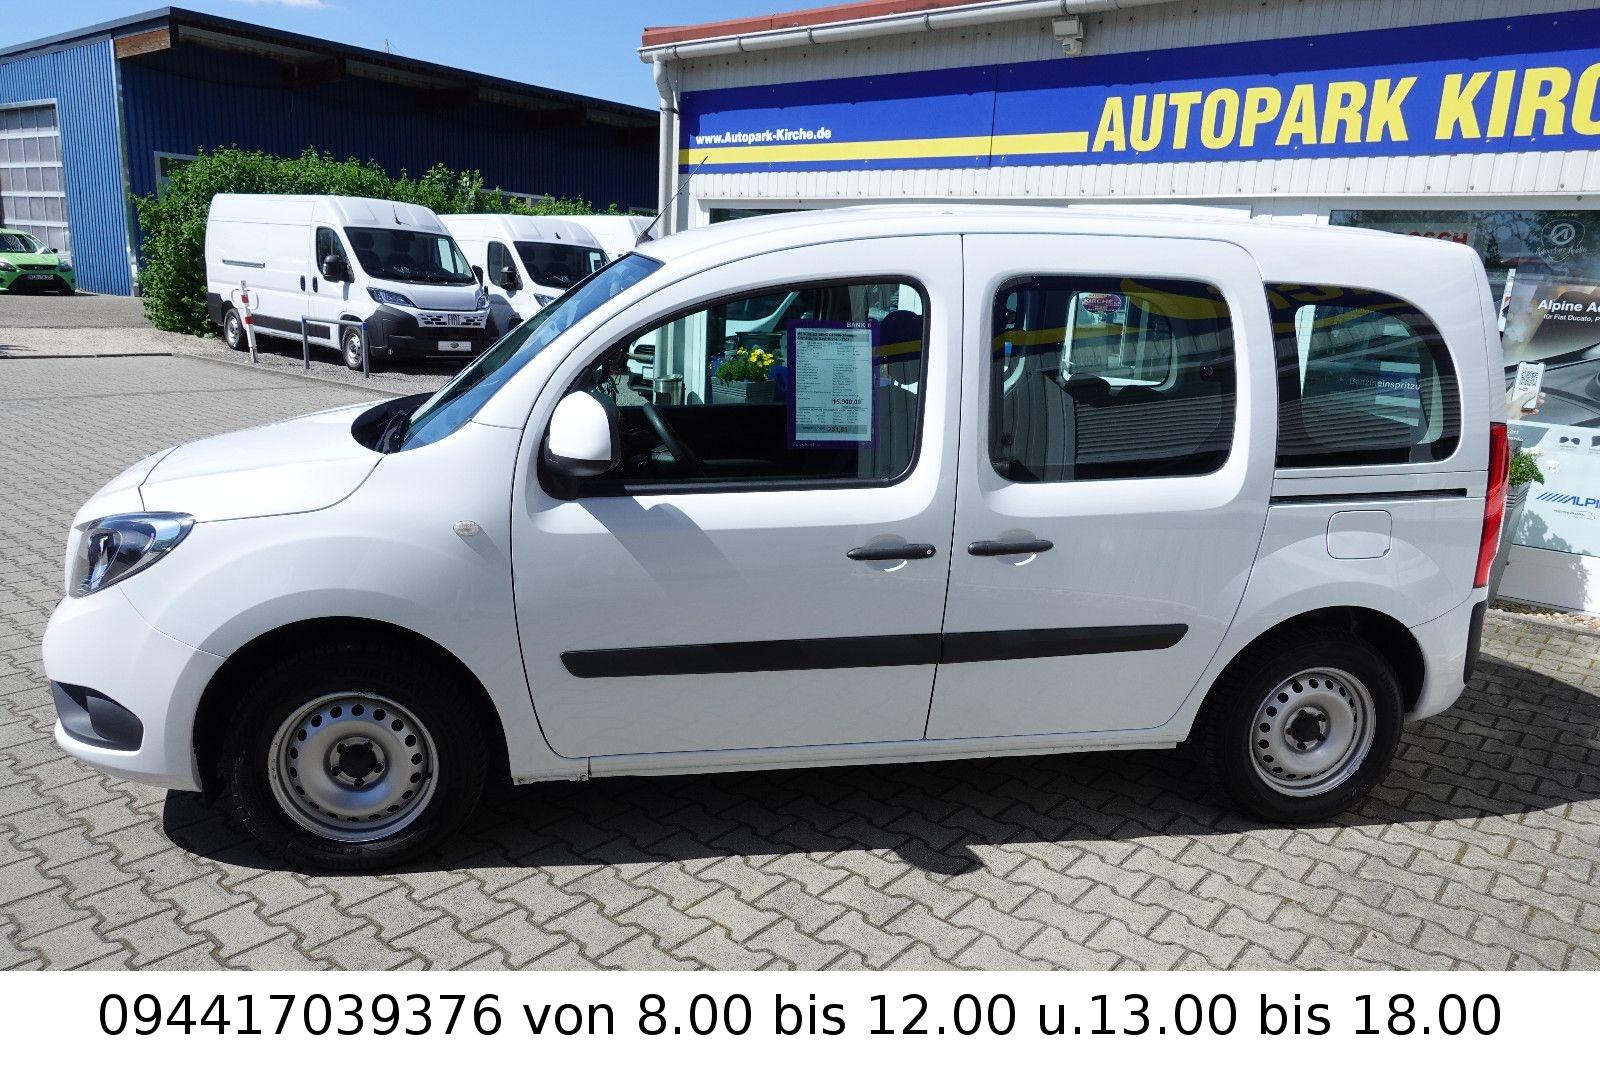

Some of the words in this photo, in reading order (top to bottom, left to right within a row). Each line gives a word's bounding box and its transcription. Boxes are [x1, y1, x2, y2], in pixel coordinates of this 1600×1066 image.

[1092, 76, 1418, 153] AUTOPARK
[695, 126, 832, 145] www.Autopark-Kirche.de
[1537, 299, 1583, 313] Alpine
[447, 313, 461, 326] FIAT
[1553, 313, 1567, 321] Fiat
[1567, 314, 1593, 322] Ducato,
